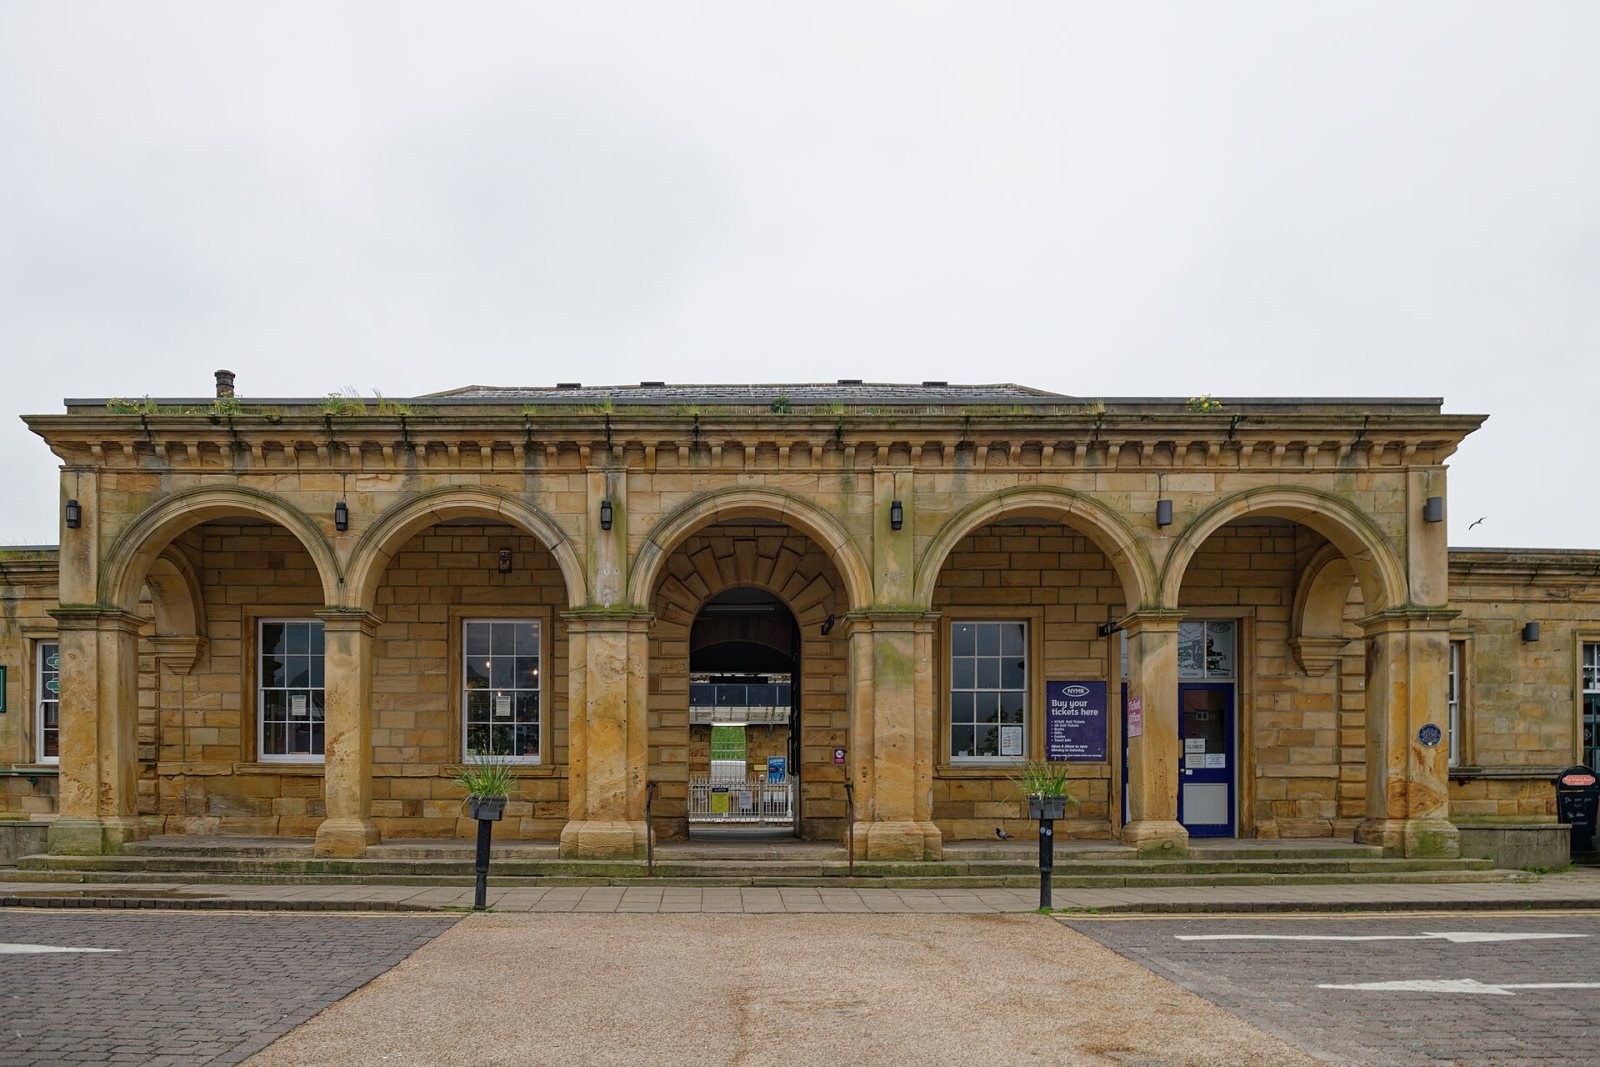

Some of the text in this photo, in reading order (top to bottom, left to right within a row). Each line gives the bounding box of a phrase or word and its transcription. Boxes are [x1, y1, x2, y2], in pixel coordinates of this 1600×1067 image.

[1051, 699, 1088, 708] Buy your
[1051, 707, 1099, 716] tickets here
